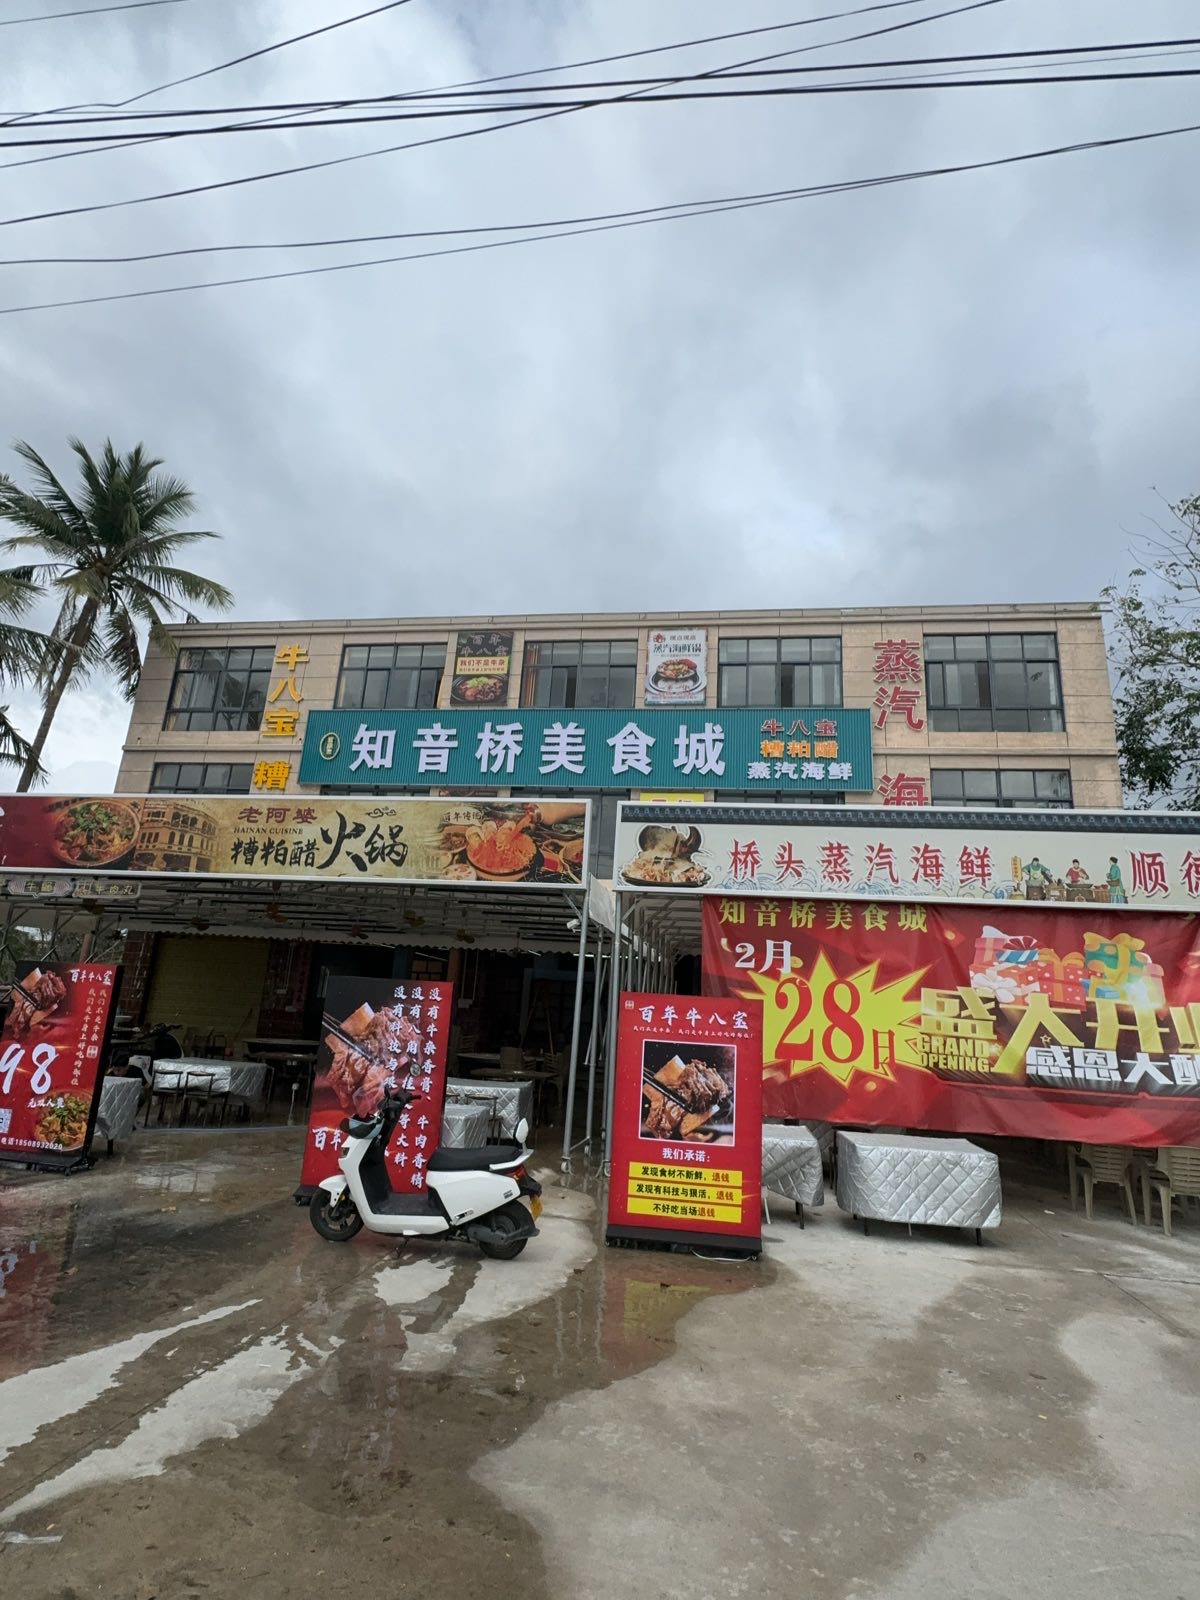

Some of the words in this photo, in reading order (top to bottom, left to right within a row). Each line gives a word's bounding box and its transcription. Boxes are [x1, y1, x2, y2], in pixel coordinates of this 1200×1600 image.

[262, 643, 311, 738] 牛八宝
[760, 718, 838, 737] 牛八宝
[349, 722, 726, 776] 知音桥美食城
[759, 739, 838, 759] 糟粕醋
[253, 760, 292, 790] 糟
[747, 761, 853, 781] 蒸汽海鲜
[237, 806, 318, 824] 老阿婆
[233, 826, 268, 835] HAINAN
[269, 827, 304, 836] CUISINE
[728, 838, 994, 888] 桥头蒸汽海鲜
[719, 898, 928, 934] 知音桥美食城
[735, 940, 793, 974] 2月
[69, 969, 113, 986] 百年牛八宝
[638, 1004, 749, 1030] 百年牛八宝
[773, 975, 897, 1070] 28日
[917, 1034, 991, 1056] GRAND
[919, 1053, 991, 1073] OPENING
